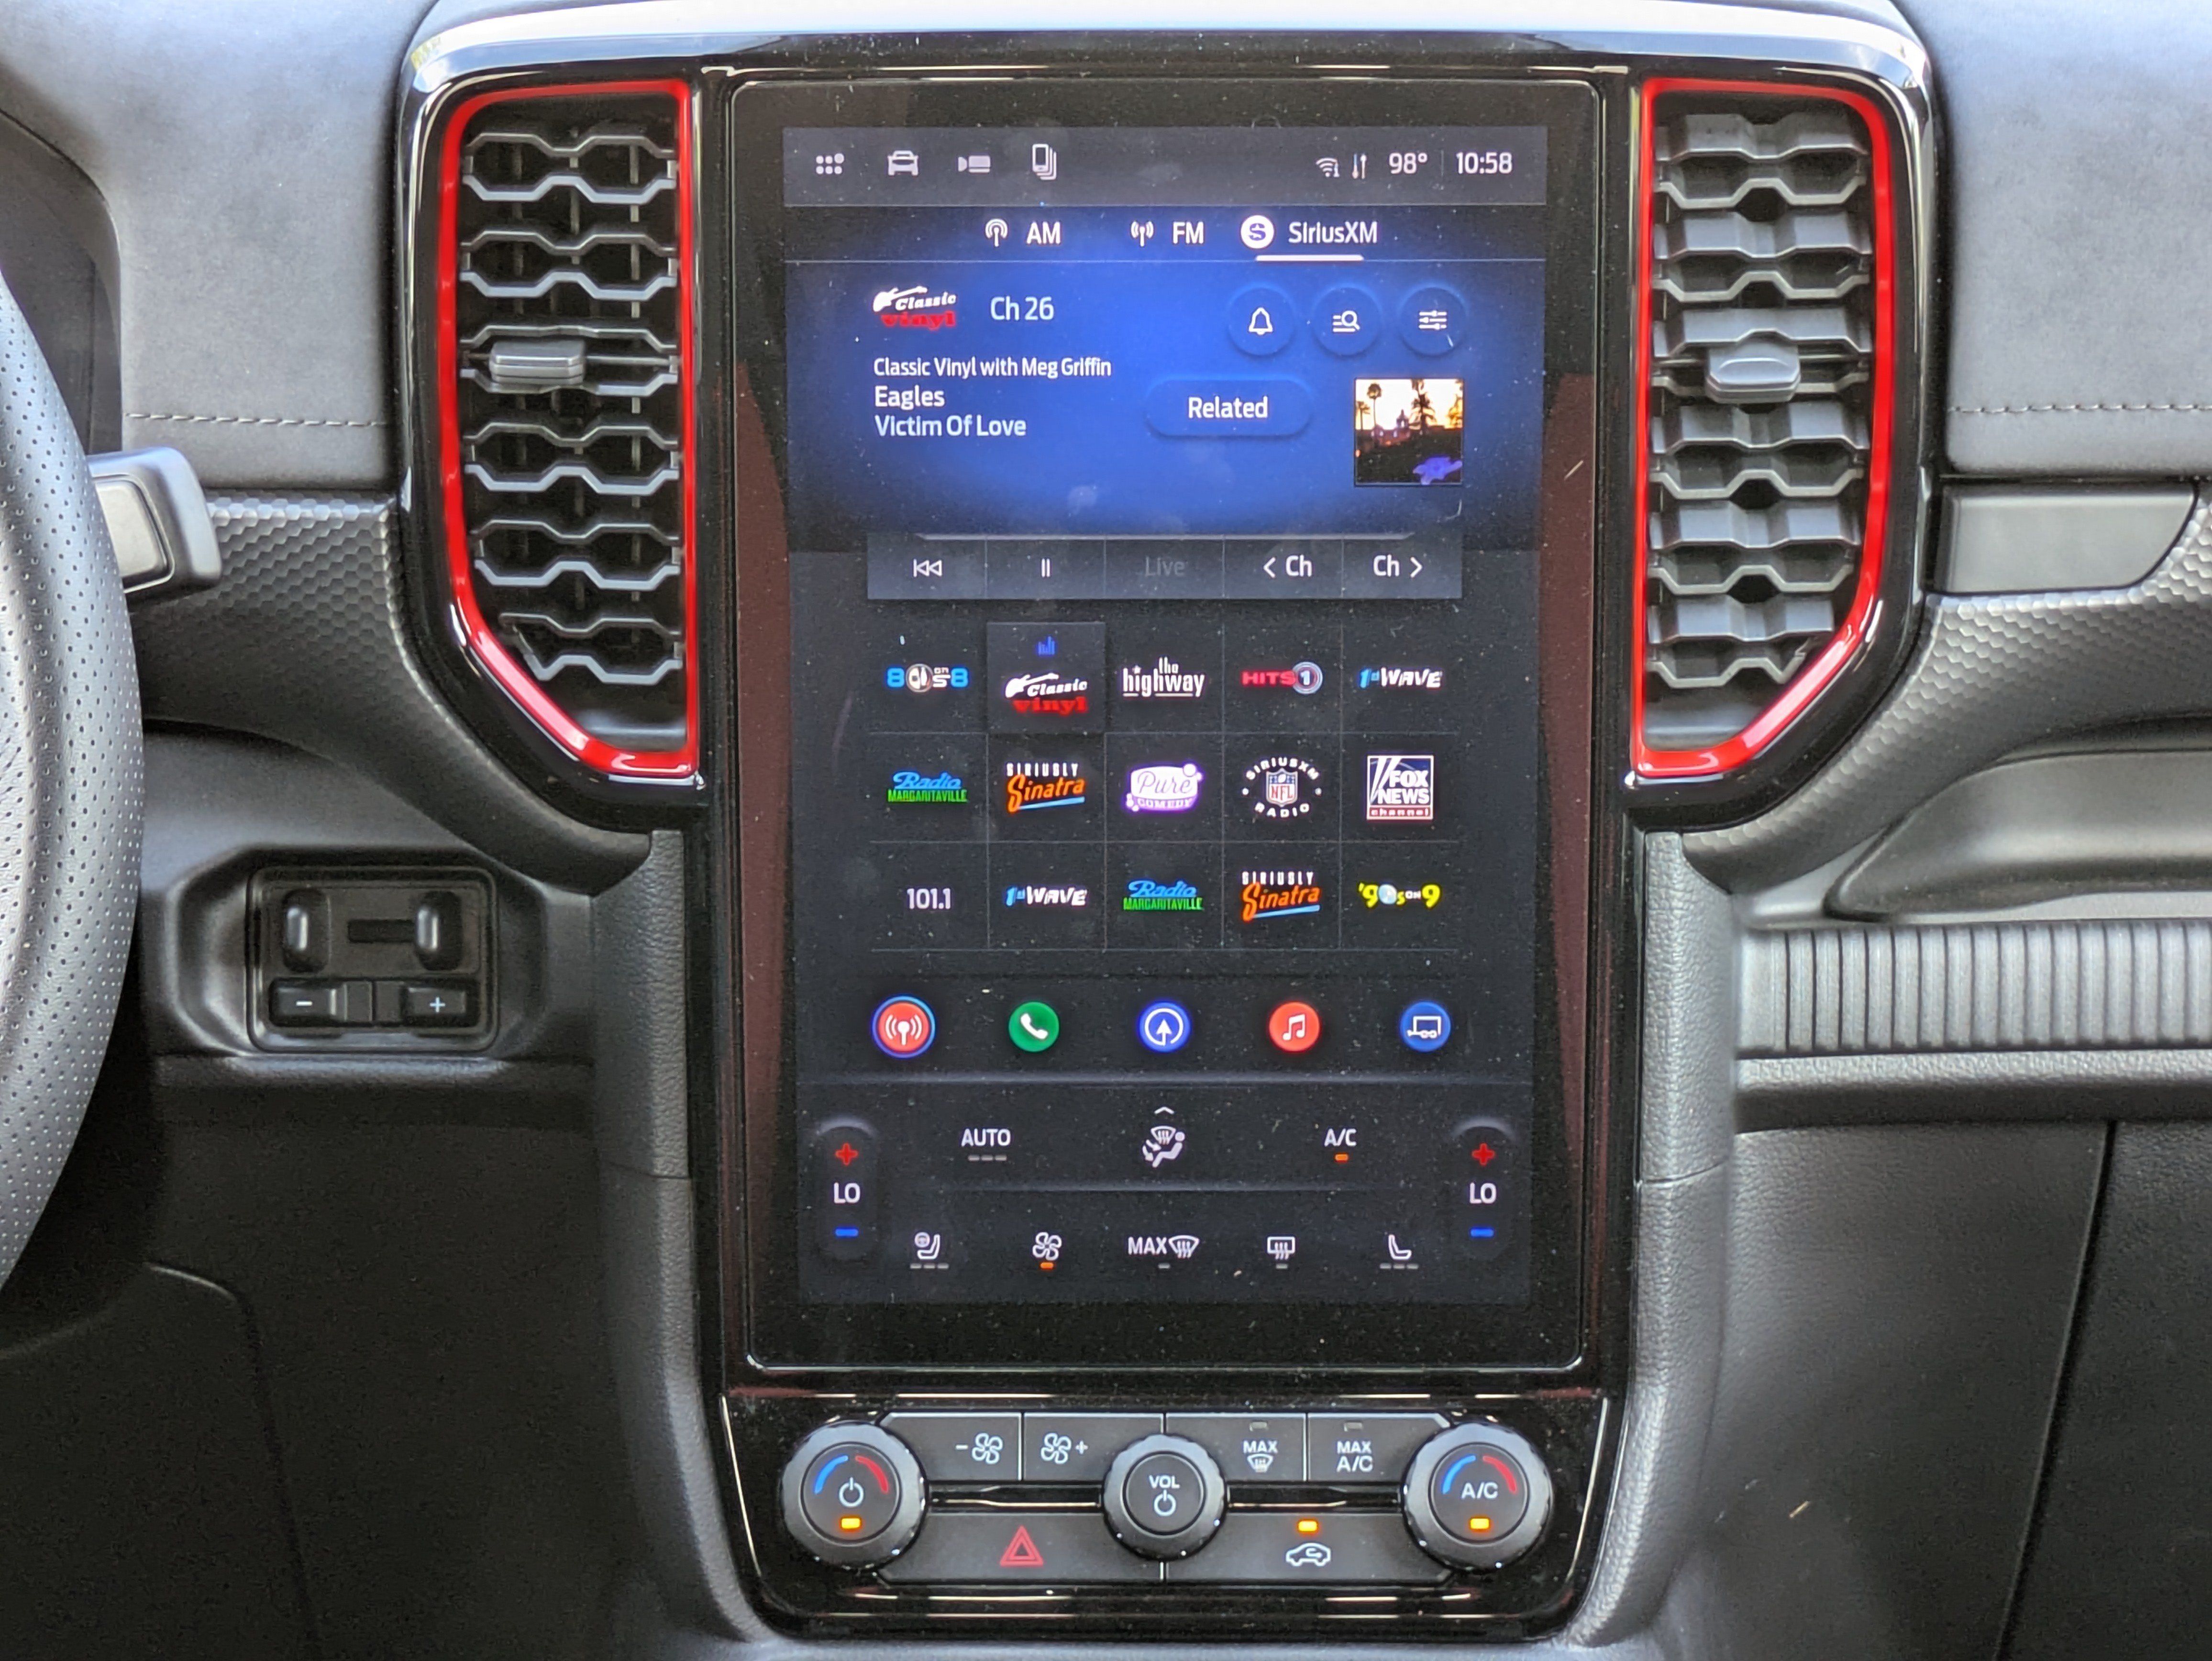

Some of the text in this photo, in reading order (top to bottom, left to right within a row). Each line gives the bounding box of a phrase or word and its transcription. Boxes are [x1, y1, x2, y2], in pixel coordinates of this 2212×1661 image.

[1456, 151, 1513, 175] 10:58
[1026, 221, 1061, 244] AM
[1172, 221, 1204, 244] FM
[1288, 221, 1378, 244] SiriusXM
[895, 292, 956, 311] Classic
[990, 297, 1054, 321] Ch 26
[881, 310, 955, 331] vinyl
[874, 356, 1111, 379] Classic Vinyl with Meg Griffin
[874, 386, 945, 410] Eagles
[1188, 396, 1268, 419] Related
[875, 415, 1026, 436] Victim Of Love
[1145, 556, 1184, 576] Live
[1285, 555, 1312, 577] Ch
[1373, 555, 1400, 577] Ch
[1159, 657, 1179, 673] the
[1027, 678, 1087, 697] Classic
[1123, 668, 1205, 697] highway
[1243, 671, 1295, 685] HITS
[1014, 697, 1087, 715] vinyl
[1246, 757, 1320, 781] SIRIUSXM
[1389, 770, 1427, 787] FOX
[893, 772, 961, 789] Radio
[1139, 775, 1193, 795] Pure
[1008, 774, 1085, 812] Sinatra
[1271, 786, 1293, 799] NFL
[1378, 788, 1429, 805] NEWS
[1254, 803, 1310, 819] RADIO
[907, 888, 951, 909] 101.1
[1129, 881, 1196, 898] Radio
[1243, 883, 1320, 921] Sinatra
[961, 1129, 1011, 1147] AUTO
[1324, 1129, 1357, 1147] A/C
[834, 1183, 861, 1204] LO
[1470, 1183, 1496, 1204] LO
[1128, 1237, 1167, 1255] MAX
[1243, 1441, 1277, 1453] MAX
[1338, 1441, 1371, 1453] MAX
[1338, 1456, 1373, 1472] A/C
[1149, 1475, 1180, 1489] VOL
[1461, 1483, 1498, 1499] A/C
